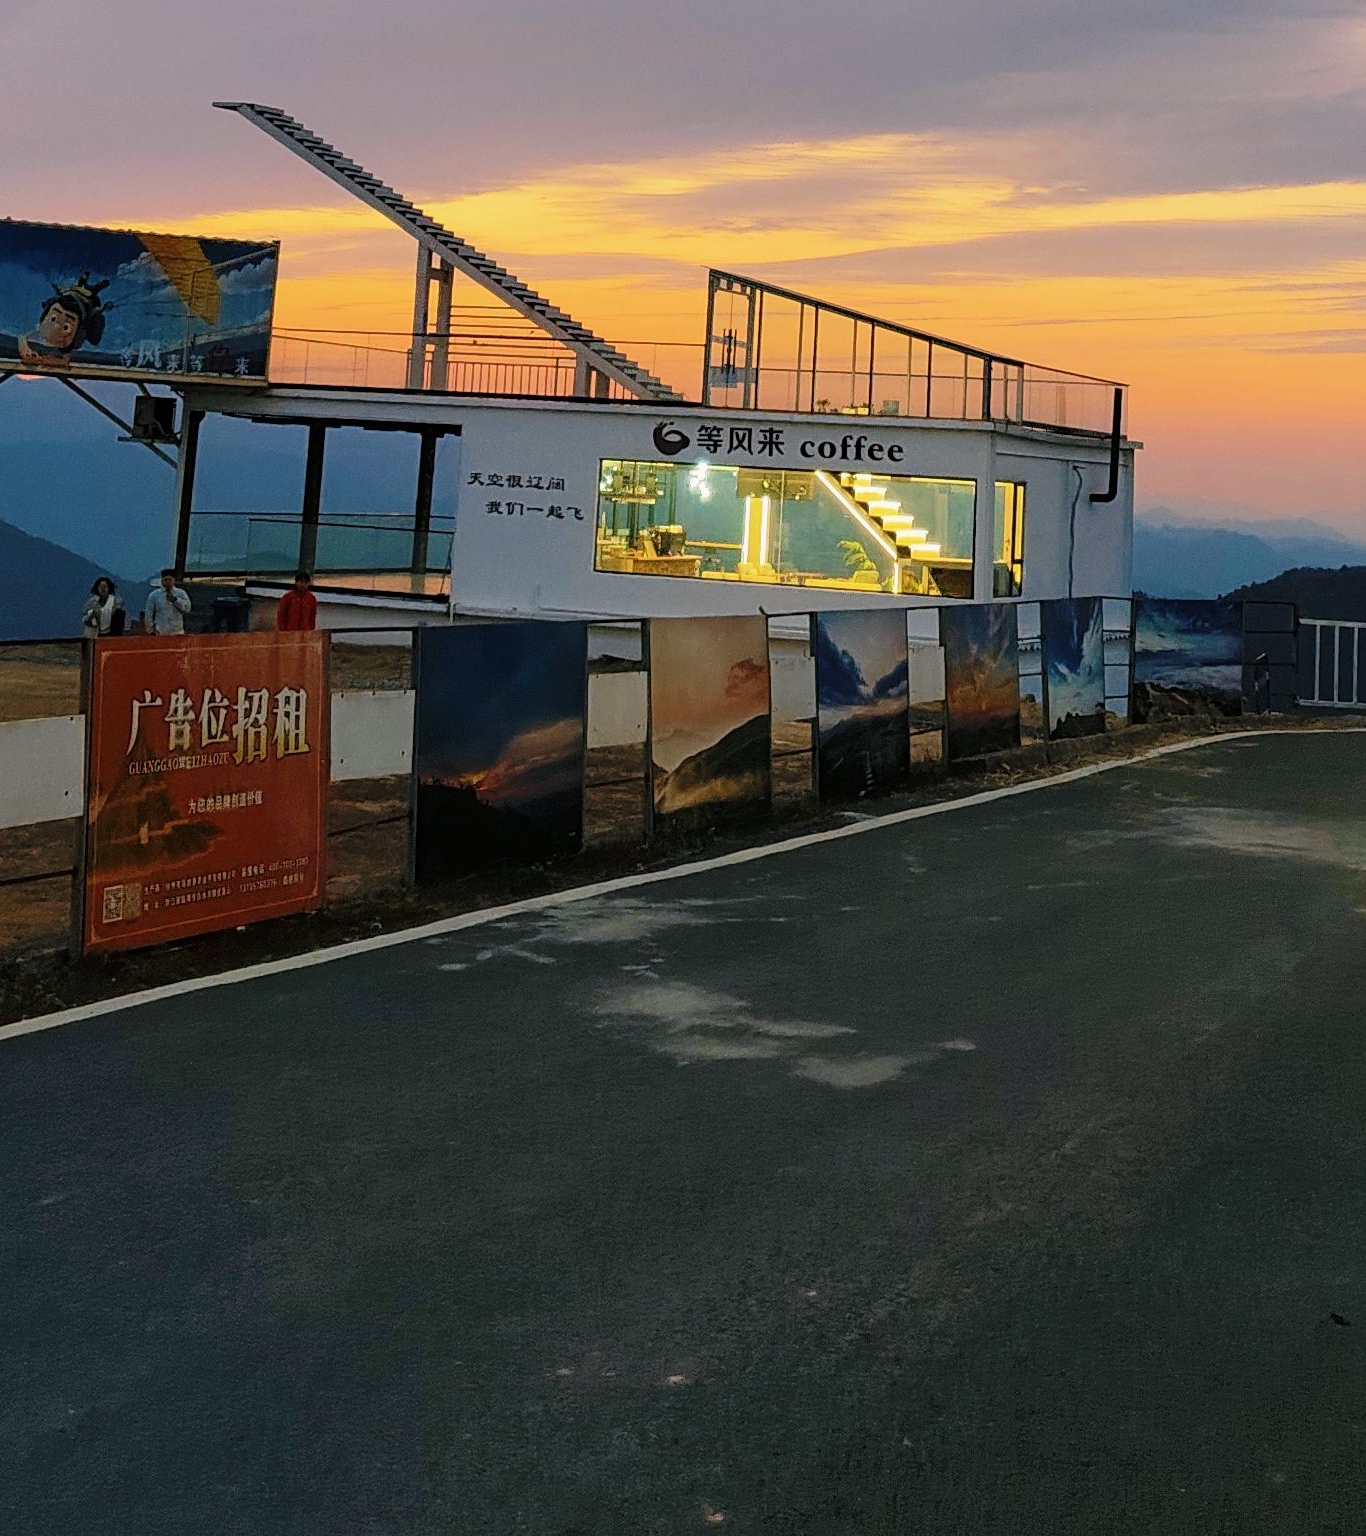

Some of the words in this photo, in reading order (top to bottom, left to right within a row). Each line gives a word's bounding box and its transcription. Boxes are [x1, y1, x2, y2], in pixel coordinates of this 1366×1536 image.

[696, 424, 785, 457] 等风来
[800, 434, 904, 462] coffee
[467, 472, 565, 492] 天空很辽阔
[485, 500, 584, 521] 我们一起飞
[126, 686, 311, 764] 广告位招租
